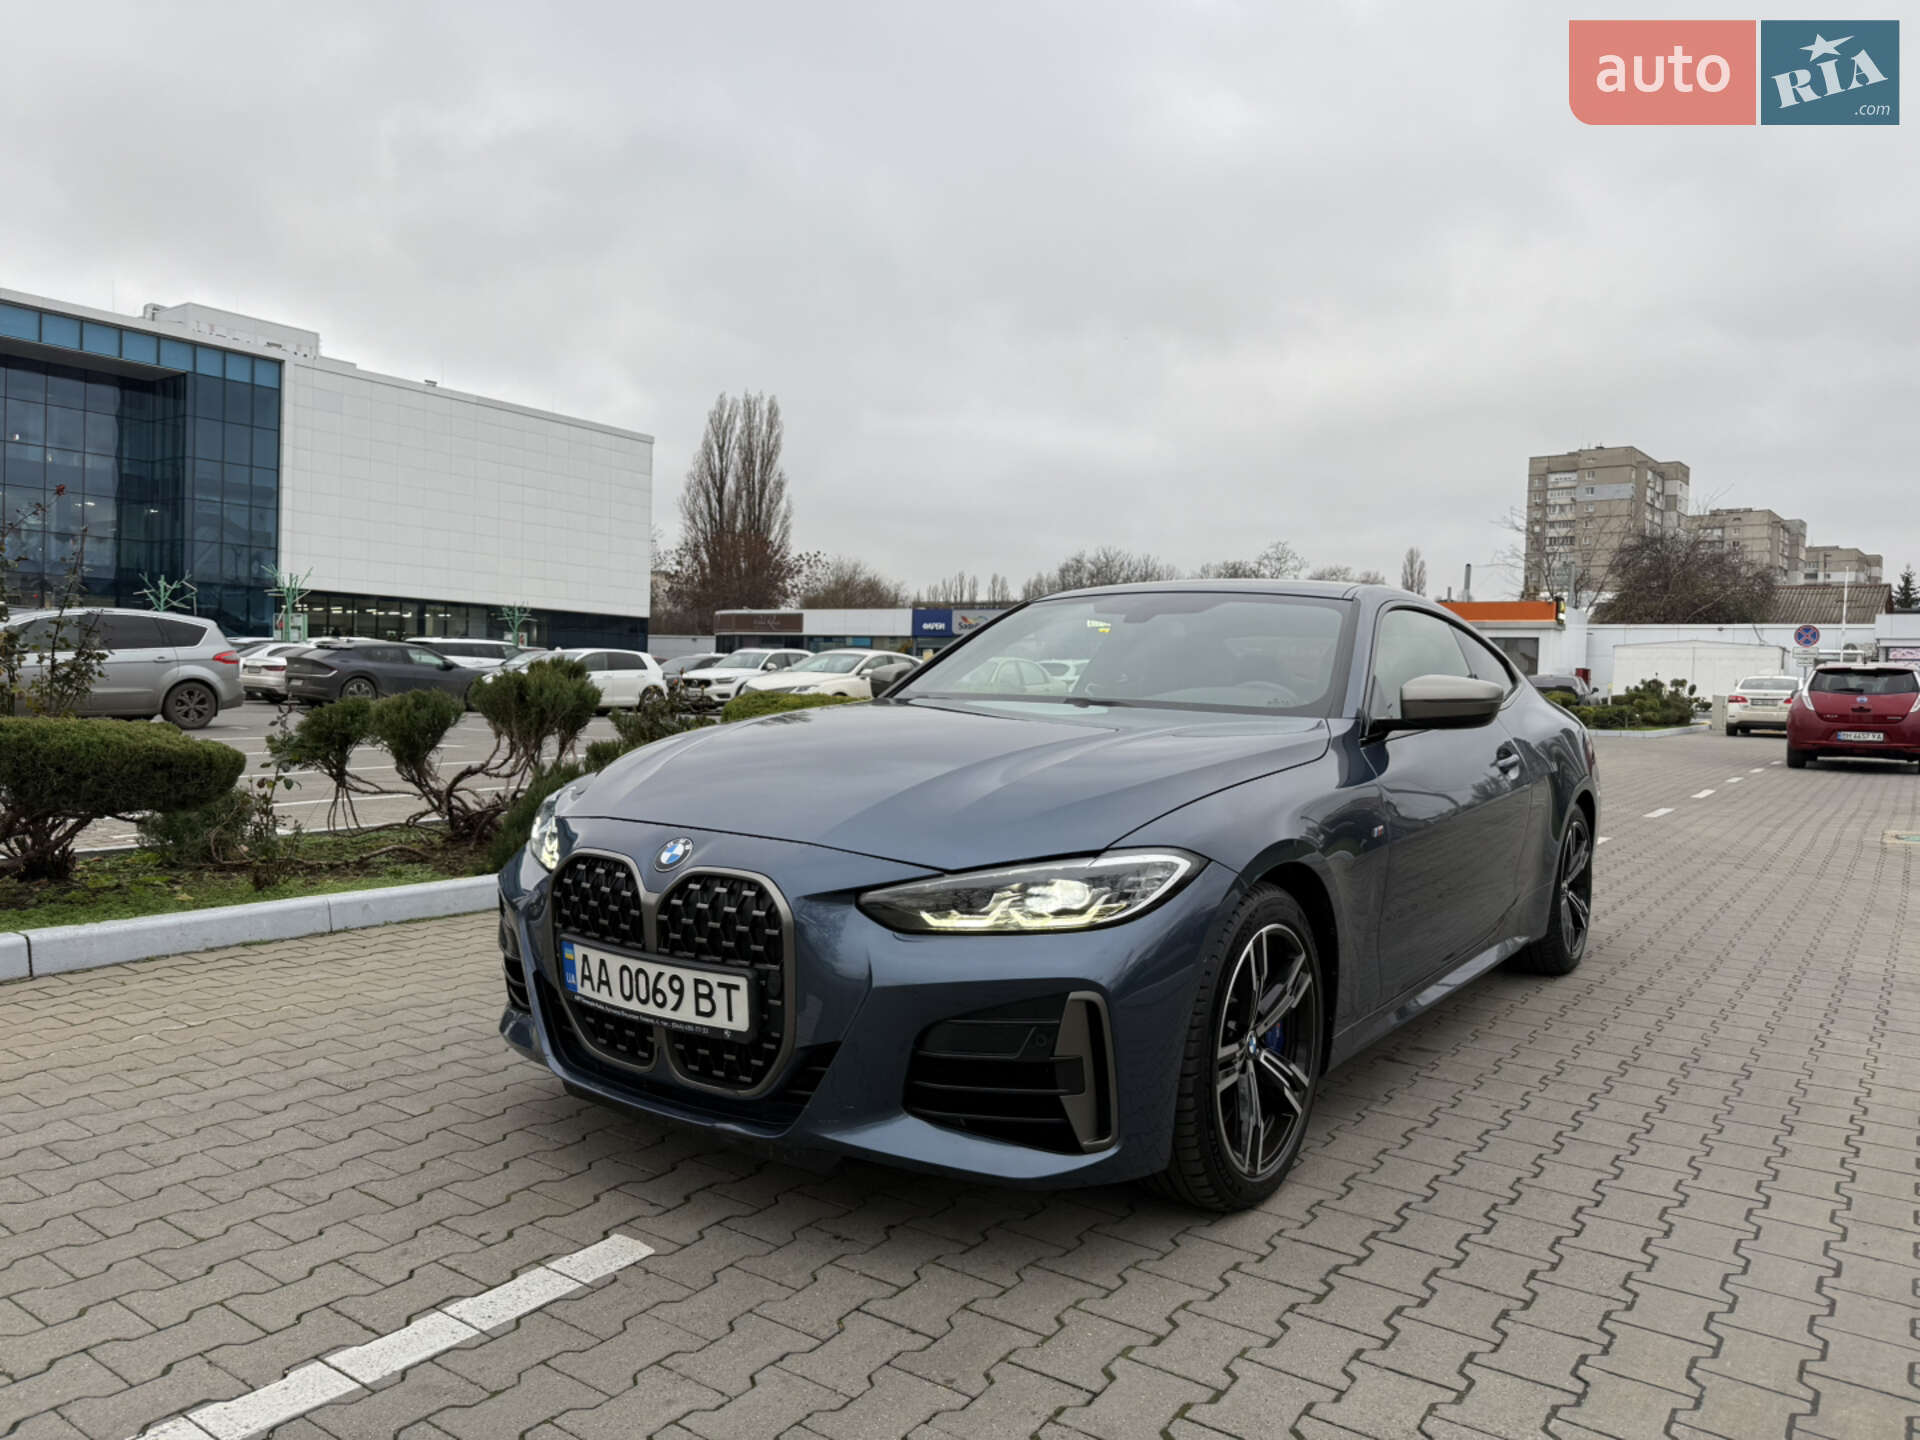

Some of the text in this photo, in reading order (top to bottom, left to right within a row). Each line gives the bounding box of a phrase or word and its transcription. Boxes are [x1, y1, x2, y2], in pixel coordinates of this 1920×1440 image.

[580, 953, 613, 998] AA
[619, 964, 685, 1012] 0069
[693, 976, 741, 1022] BT
